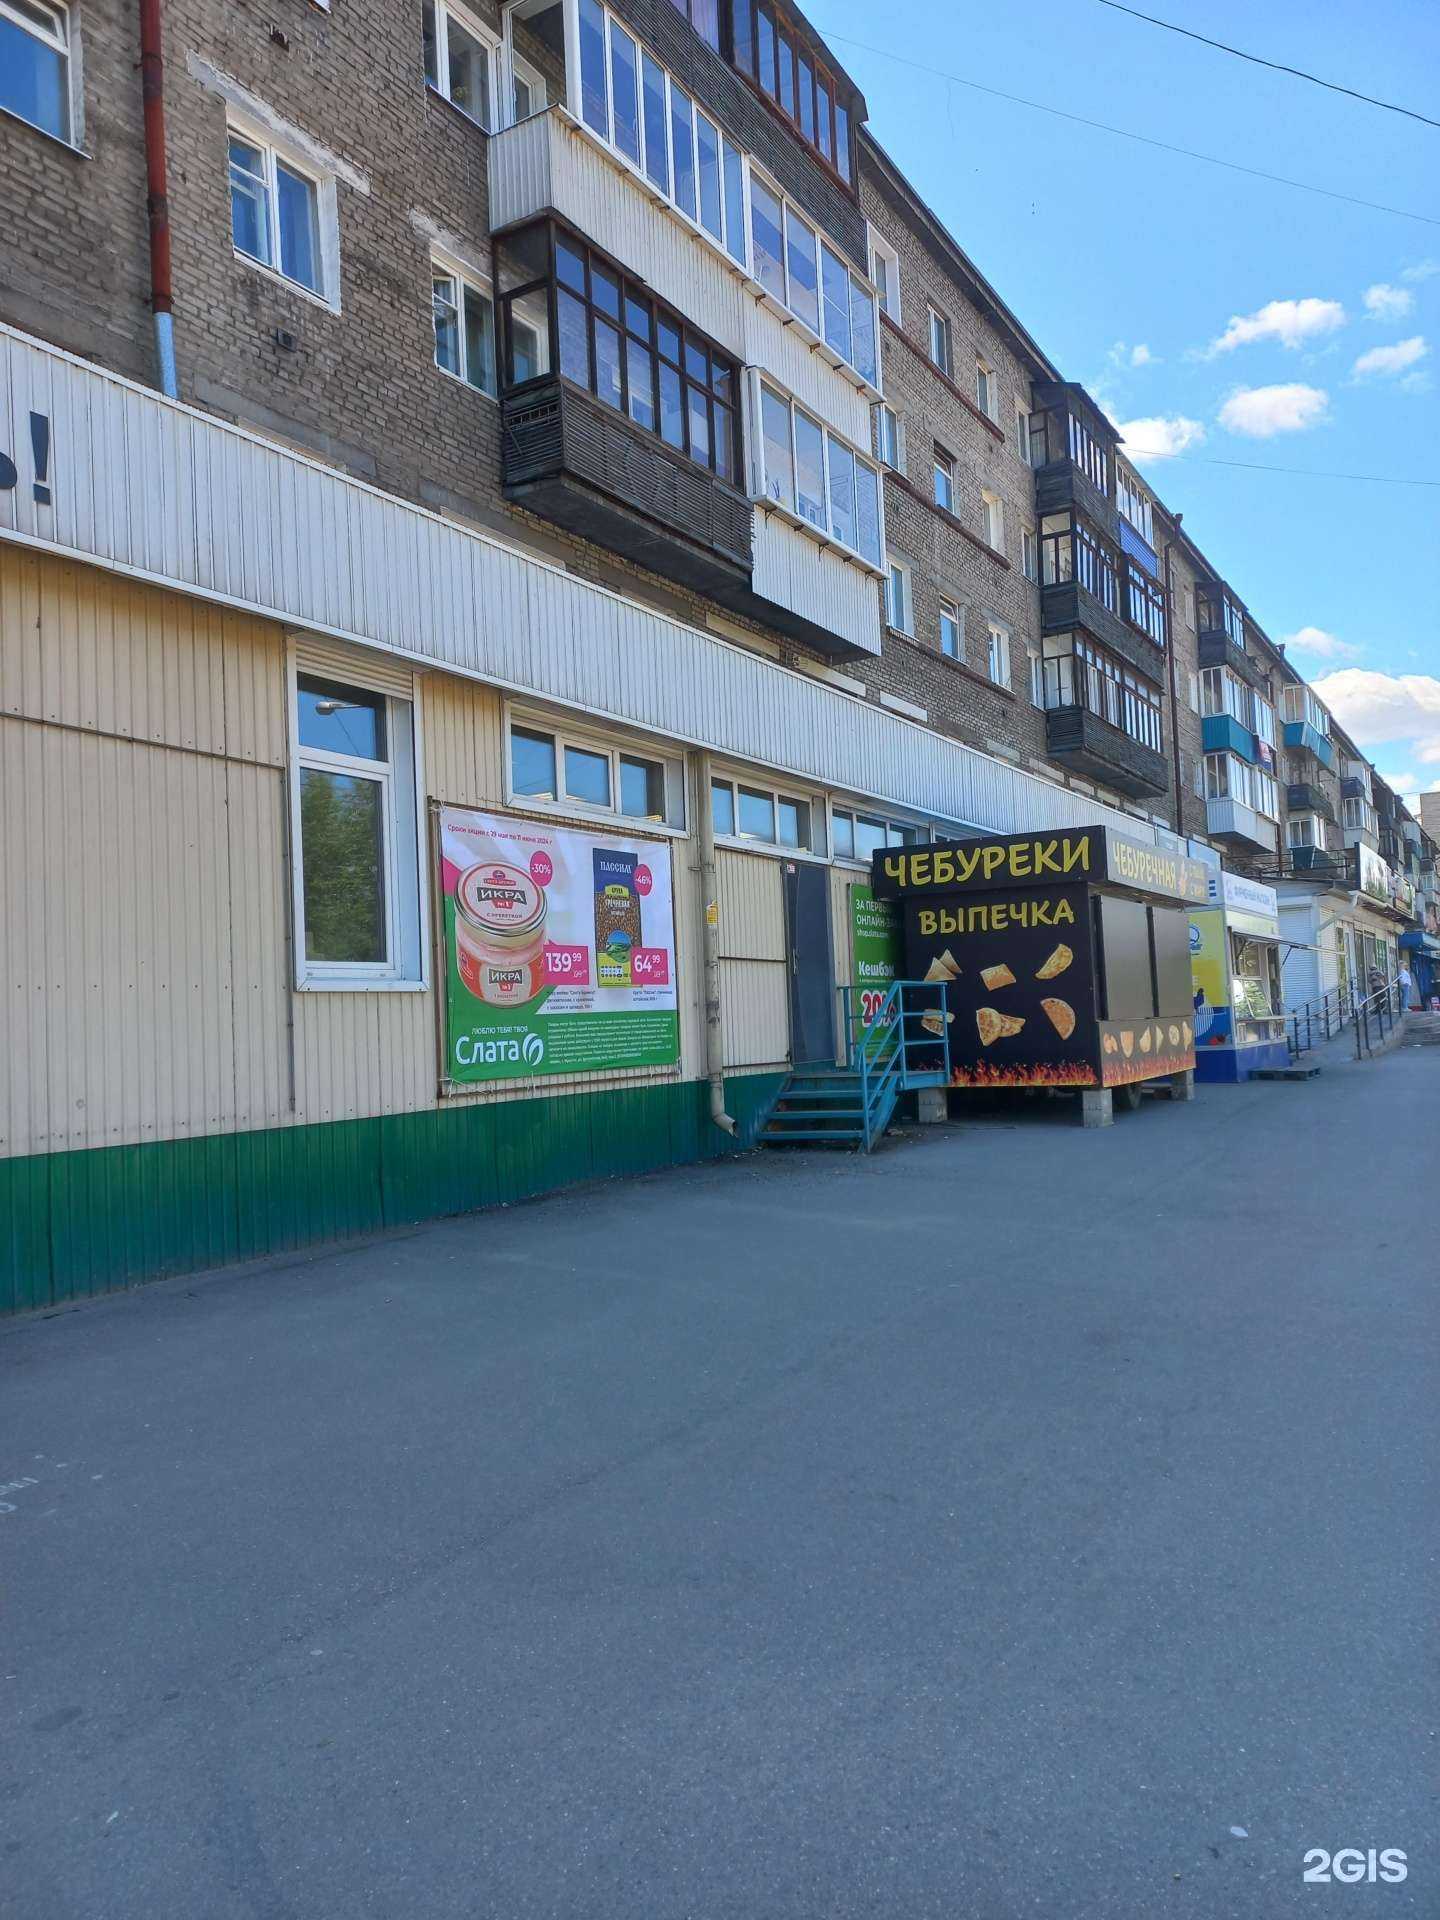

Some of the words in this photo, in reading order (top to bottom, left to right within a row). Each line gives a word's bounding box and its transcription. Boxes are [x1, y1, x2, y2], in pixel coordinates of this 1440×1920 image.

[531, 864, 551, 874] -30%
[885, 837, 1090, 887] ЧЕБУРЕКИ
[1112, 841, 1176, 890] ЧЕБУРЕЧНАЯ
[481, 889, 523, 901] ИКРА
[856, 899, 865, 910] ЗА
[919, 899, 1075, 934] ВЫПЕЧКА
[546, 953, 571, 972] 139
[634, 955, 652, 972] 64
[492, 971, 520, 981] ИКРА
[456, 1036, 519, 1064] Слата
